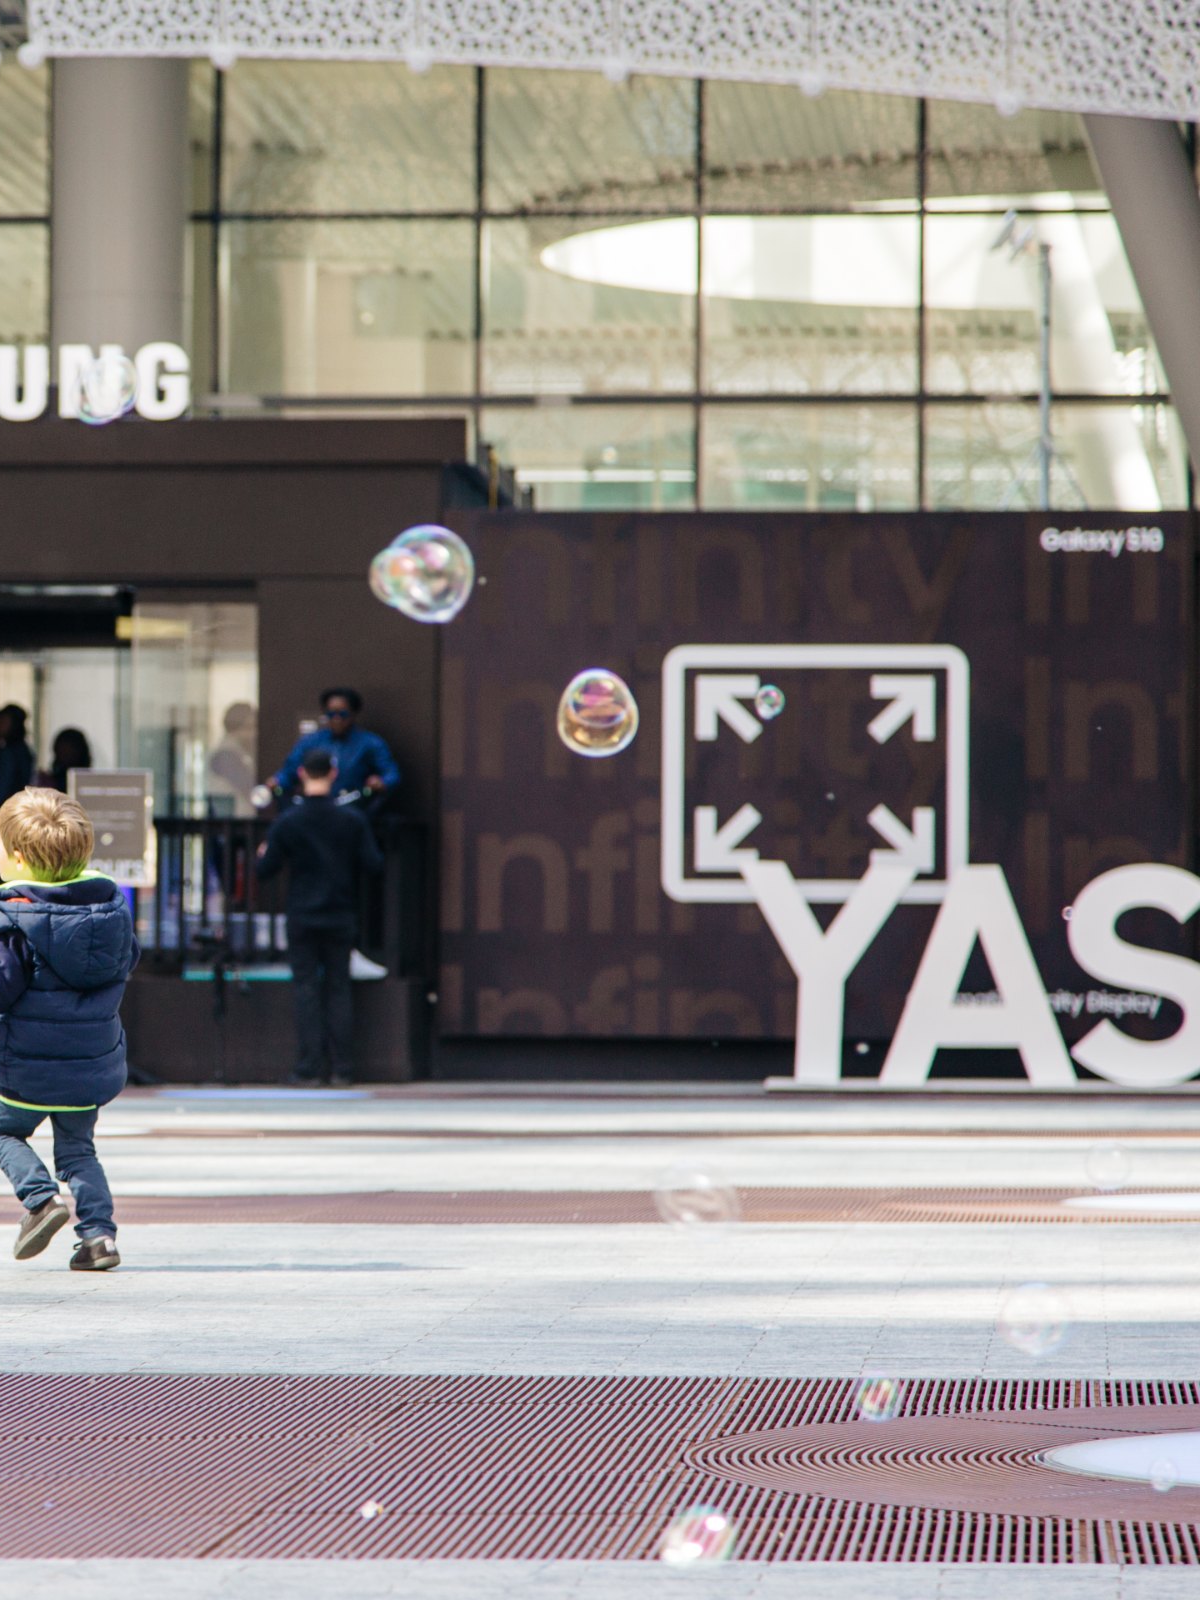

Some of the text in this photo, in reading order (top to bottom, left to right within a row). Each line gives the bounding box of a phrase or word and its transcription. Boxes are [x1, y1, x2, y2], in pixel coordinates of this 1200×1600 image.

[440, 512, 973, 645] nfinity
[1039, 526, 1165, 558] Galaxy S10
[738, 859, 1200, 1088] YAS
[1086, 989, 1162, 1020] Display
